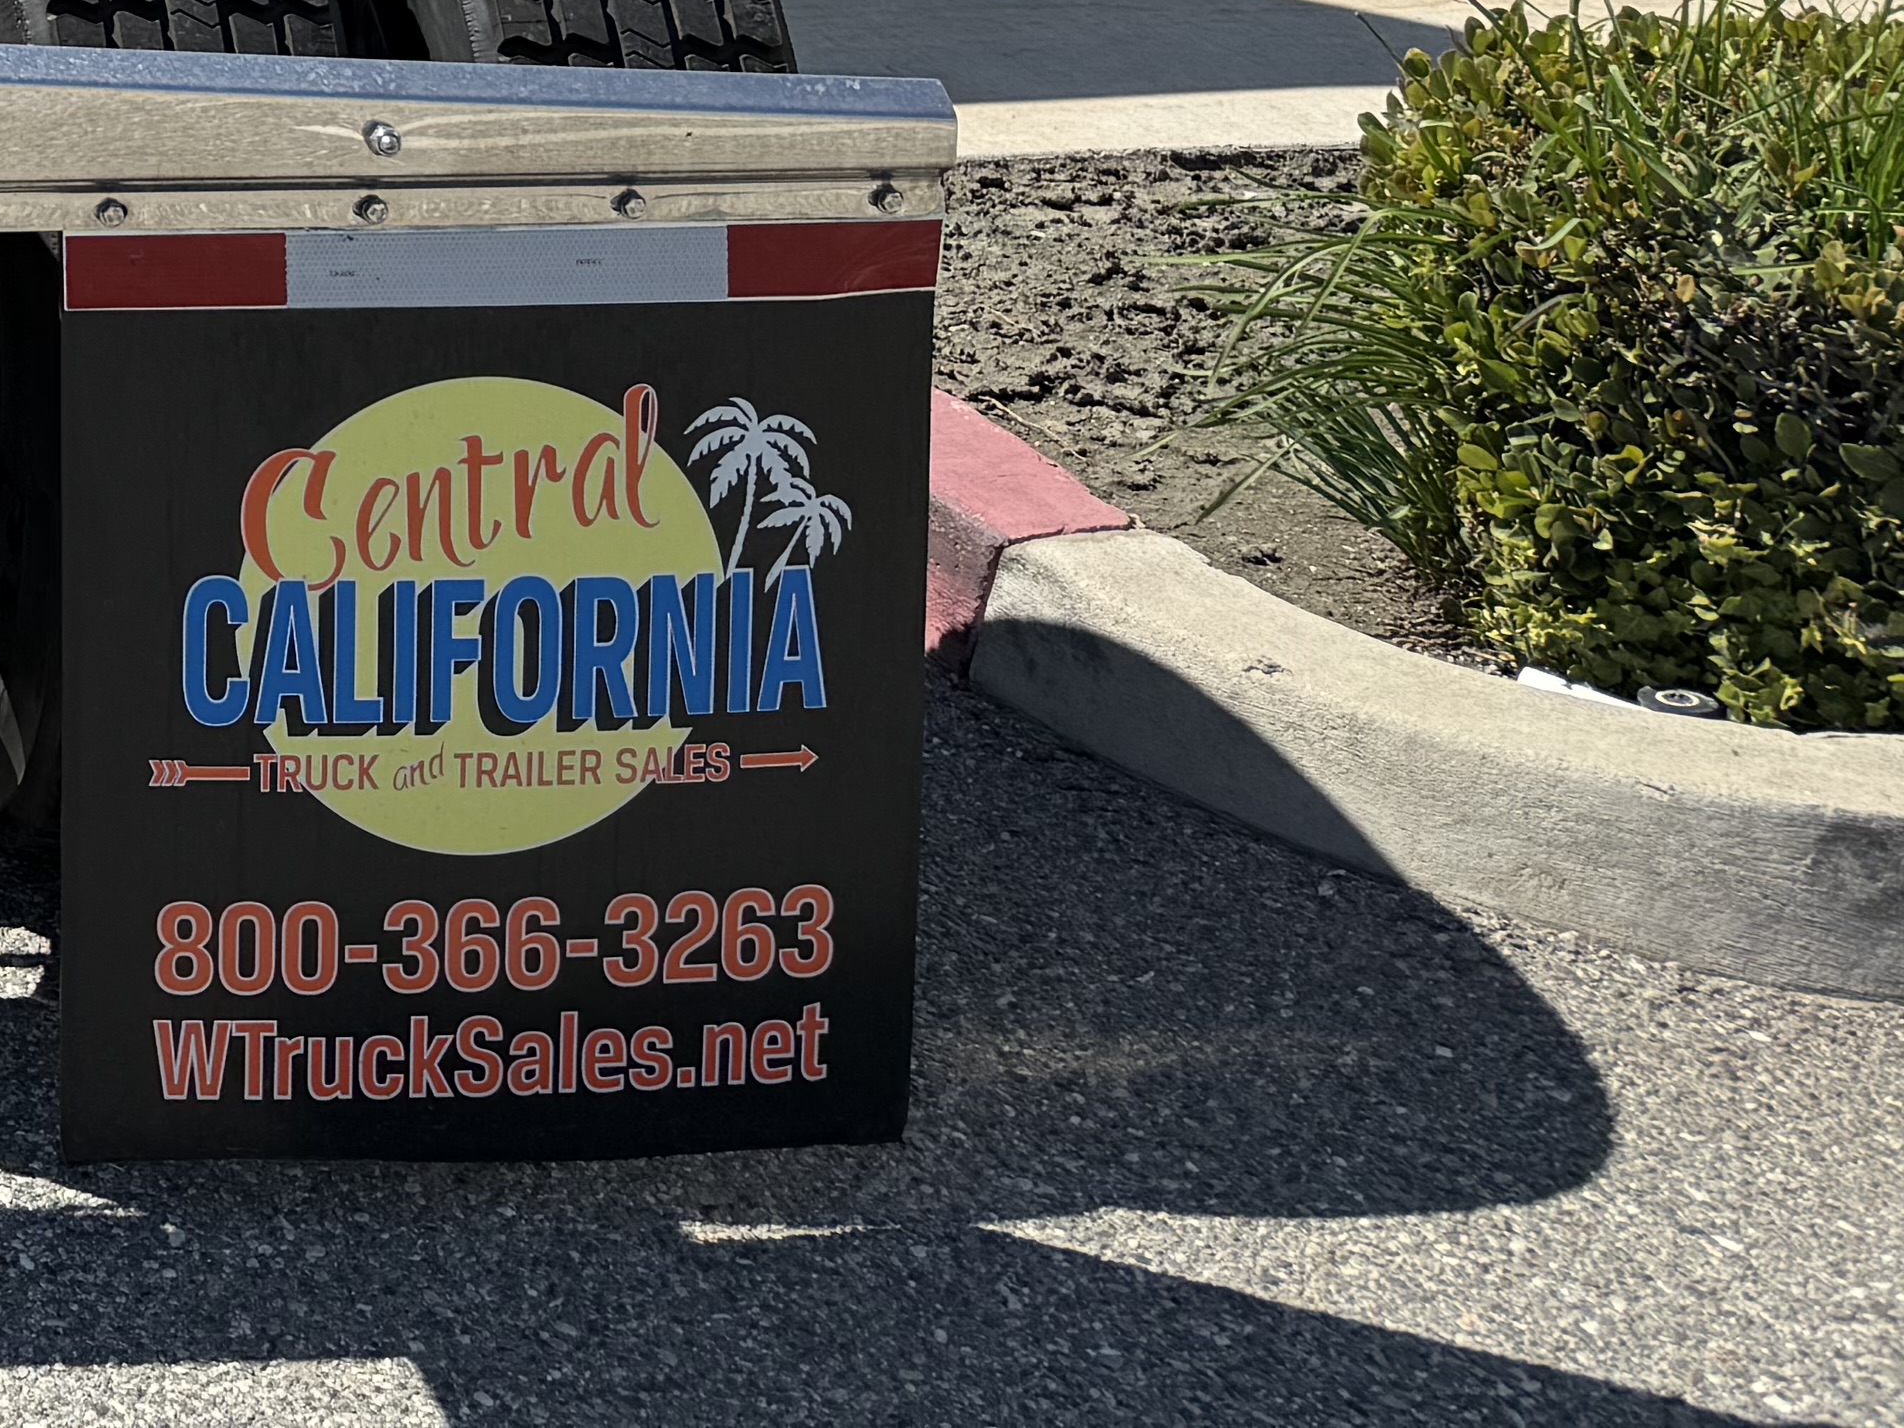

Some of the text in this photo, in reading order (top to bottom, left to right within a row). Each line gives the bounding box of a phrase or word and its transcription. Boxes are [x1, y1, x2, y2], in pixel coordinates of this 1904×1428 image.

[240, 382, 661, 592] Central
[181, 565, 828, 736] CALIFORNIA
[253, 741, 732, 793] TRUCK and TRAILER SALES
[154, 884, 834, 996] 800-366-3263
[153, 1002, 829, 1102] WTruckSales.net
